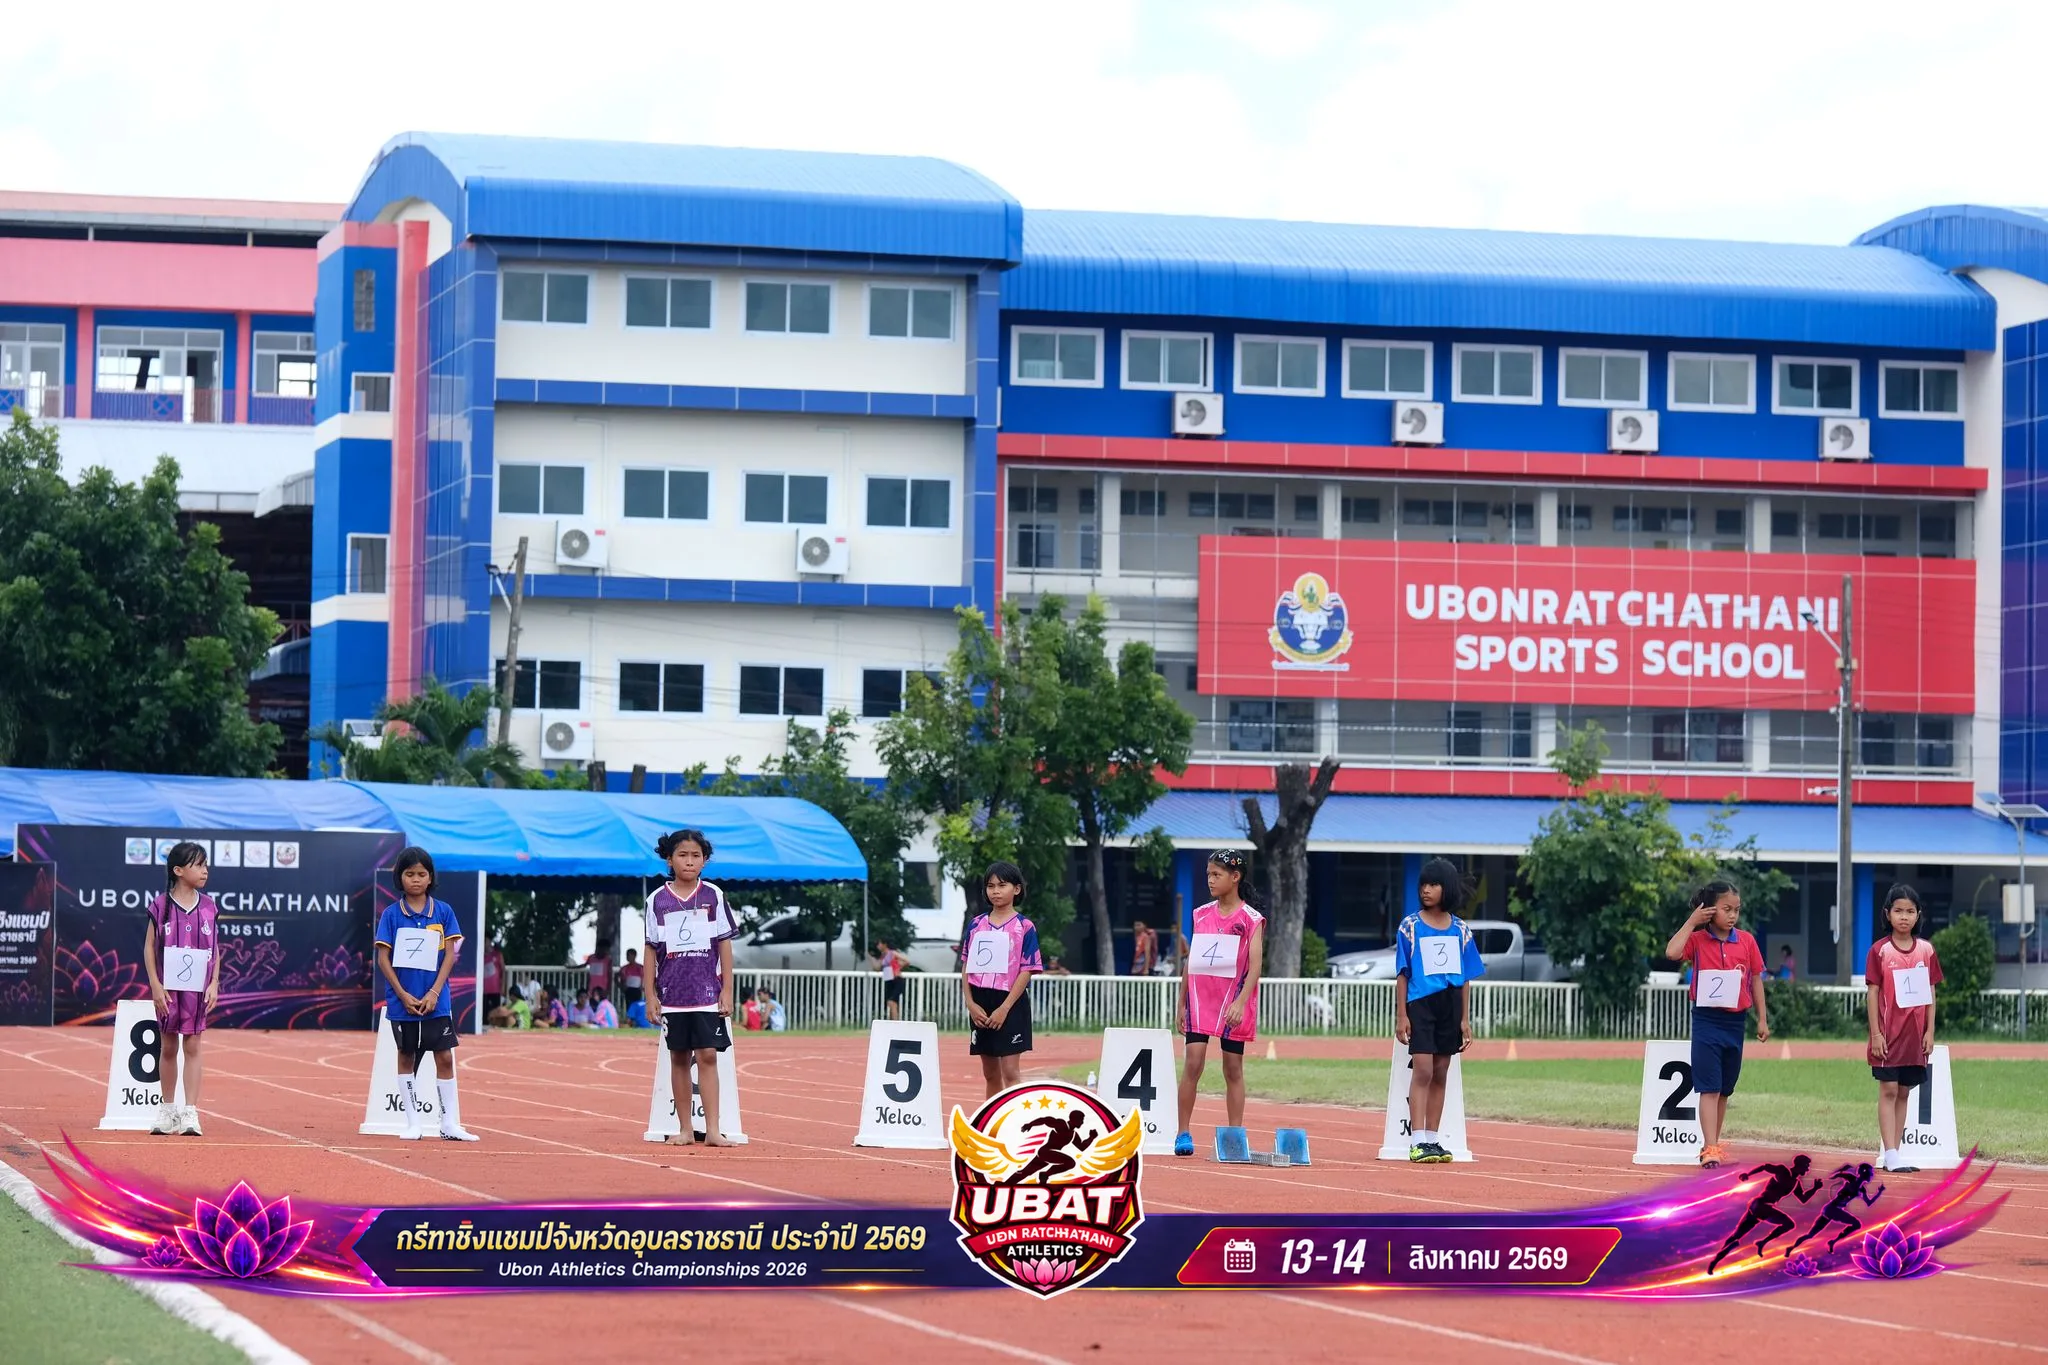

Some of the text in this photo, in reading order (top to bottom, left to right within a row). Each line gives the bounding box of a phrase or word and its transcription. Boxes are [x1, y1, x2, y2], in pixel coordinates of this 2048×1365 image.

[1406, 584, 1839, 633] UBONRATCHATHANI
[1455, 635, 1805, 680] SPORTS SCHOOL
[79, 889, 349, 913] UBONTCHATHANI
[679, 916, 691, 941] 6
[405, 938, 424, 959] 7
[976, 940, 993, 966] 5
[1202, 942, 1223, 966] 4
[1433, 943, 1448, 966] 3
[177, 954, 193, 982] 8
[1709, 977, 1723, 998] 2
[1903, 976, 1918, 994] 1
[129, 1020, 161, 1083] 8
[882, 1040, 922, 1103] 5
[1118, 1049, 1156, 1111] 4
[1658, 1061, 1696, 1120] 2
[876, 1106, 922, 1126] Nelco
[1652, 1127, 1697, 1144] Nelco
